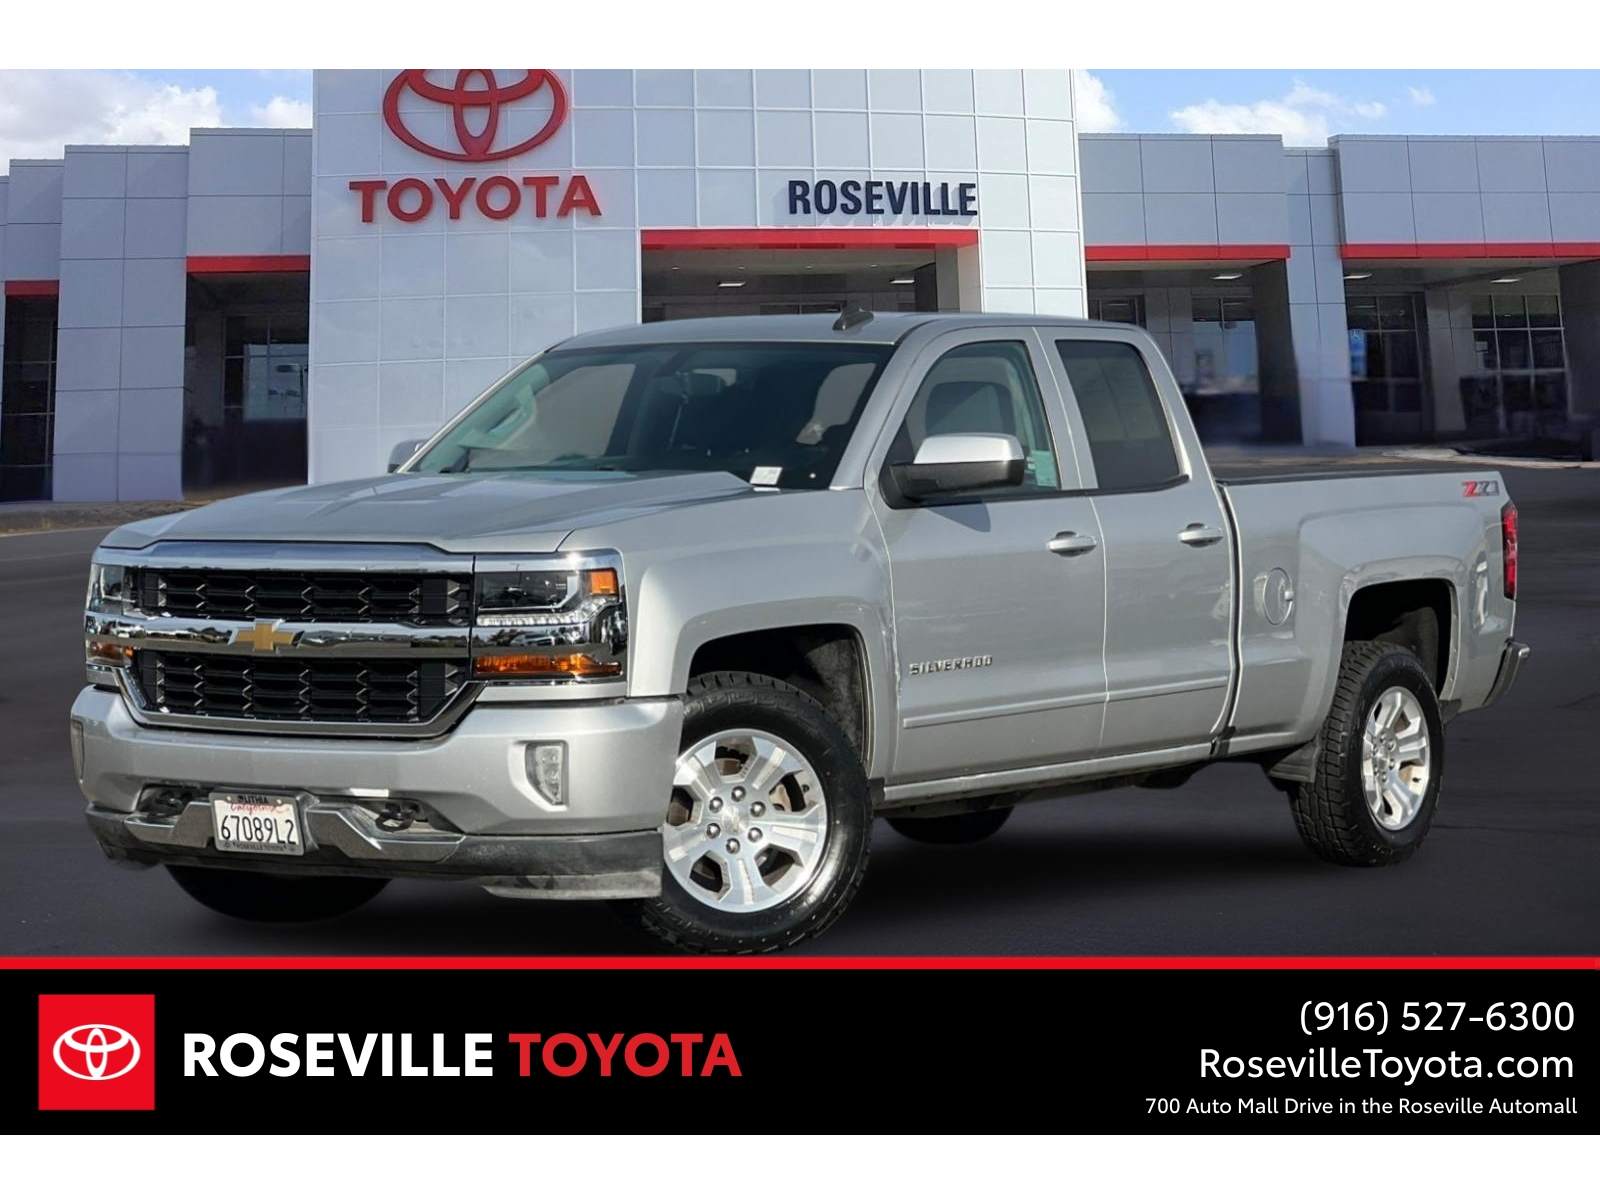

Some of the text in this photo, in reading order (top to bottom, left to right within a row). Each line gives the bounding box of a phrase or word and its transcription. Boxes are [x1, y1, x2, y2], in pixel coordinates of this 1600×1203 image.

[349, 175, 602, 222] TOYOTA
[788, 180, 978, 216] ROSEVILLE
[1462, 480, 1499, 497] Z71
[909, 655, 993, 675] SILVERADO
[221, 815, 296, 845] 67089L2
